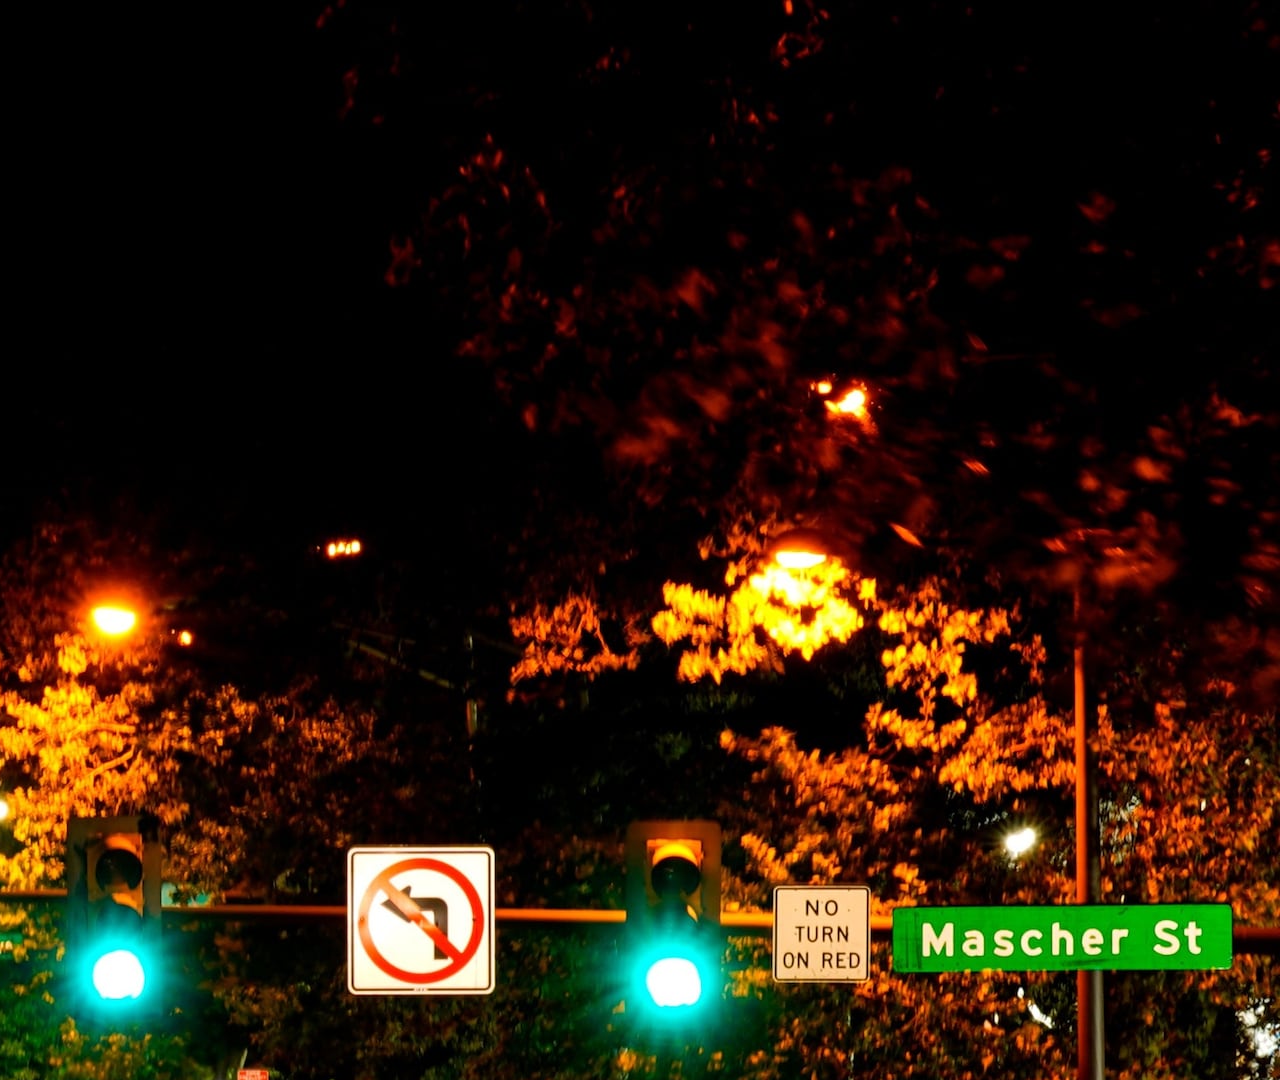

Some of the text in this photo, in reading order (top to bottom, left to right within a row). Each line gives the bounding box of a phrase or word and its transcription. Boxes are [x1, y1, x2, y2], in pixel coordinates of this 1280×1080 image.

[805, 900, 839, 916] NO
[795, 926, 849, 943] TURN
[921, 920, 1202, 958] Mascher St
[783, 952, 861, 969] ON RED
